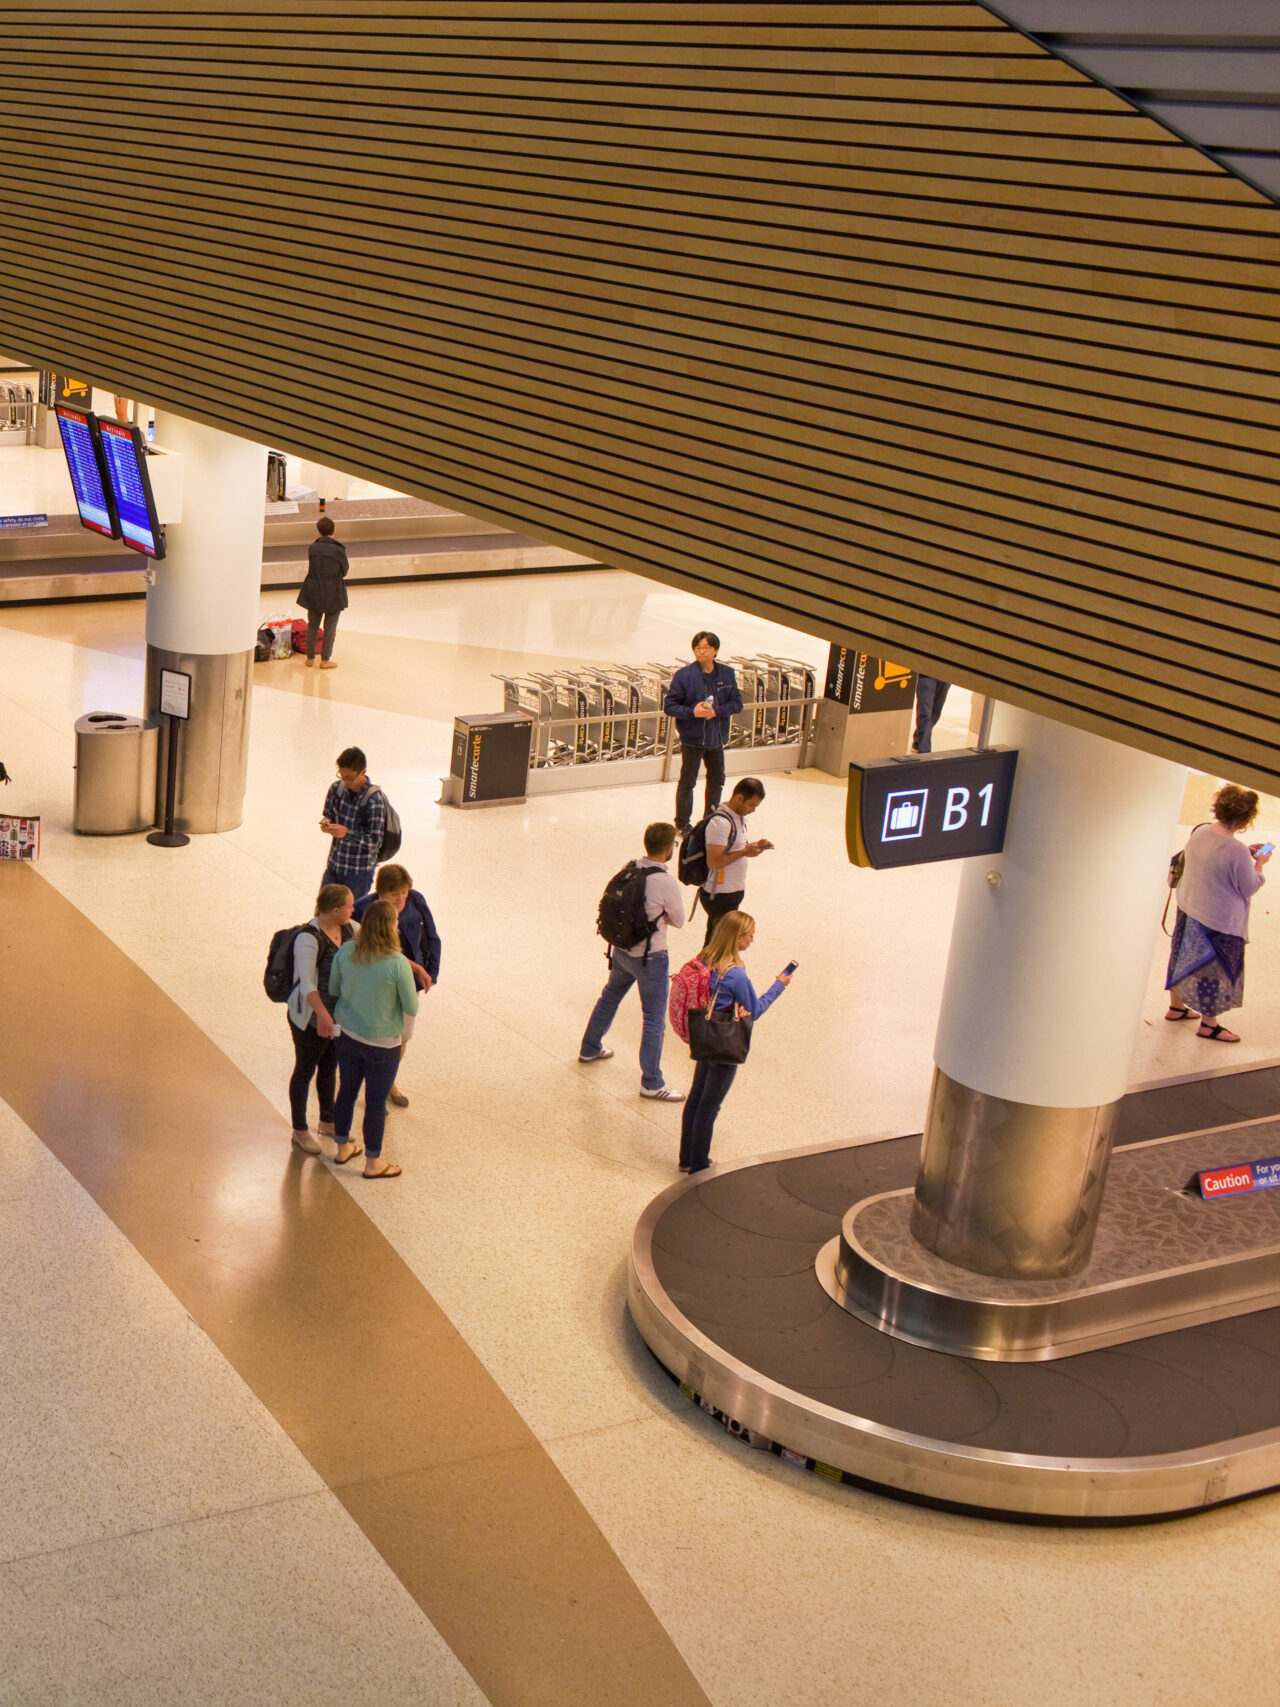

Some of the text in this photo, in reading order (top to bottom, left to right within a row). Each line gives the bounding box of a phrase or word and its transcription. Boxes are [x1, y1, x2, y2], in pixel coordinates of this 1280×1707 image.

[469, 734, 482, 799] smartecarte
[942, 783, 993, 832] B1
[1256, 1163, 1280, 1176] For yo
[1204, 1173, 1250, 1191] Caution
[1258, 1177, 1267, 1185] or
